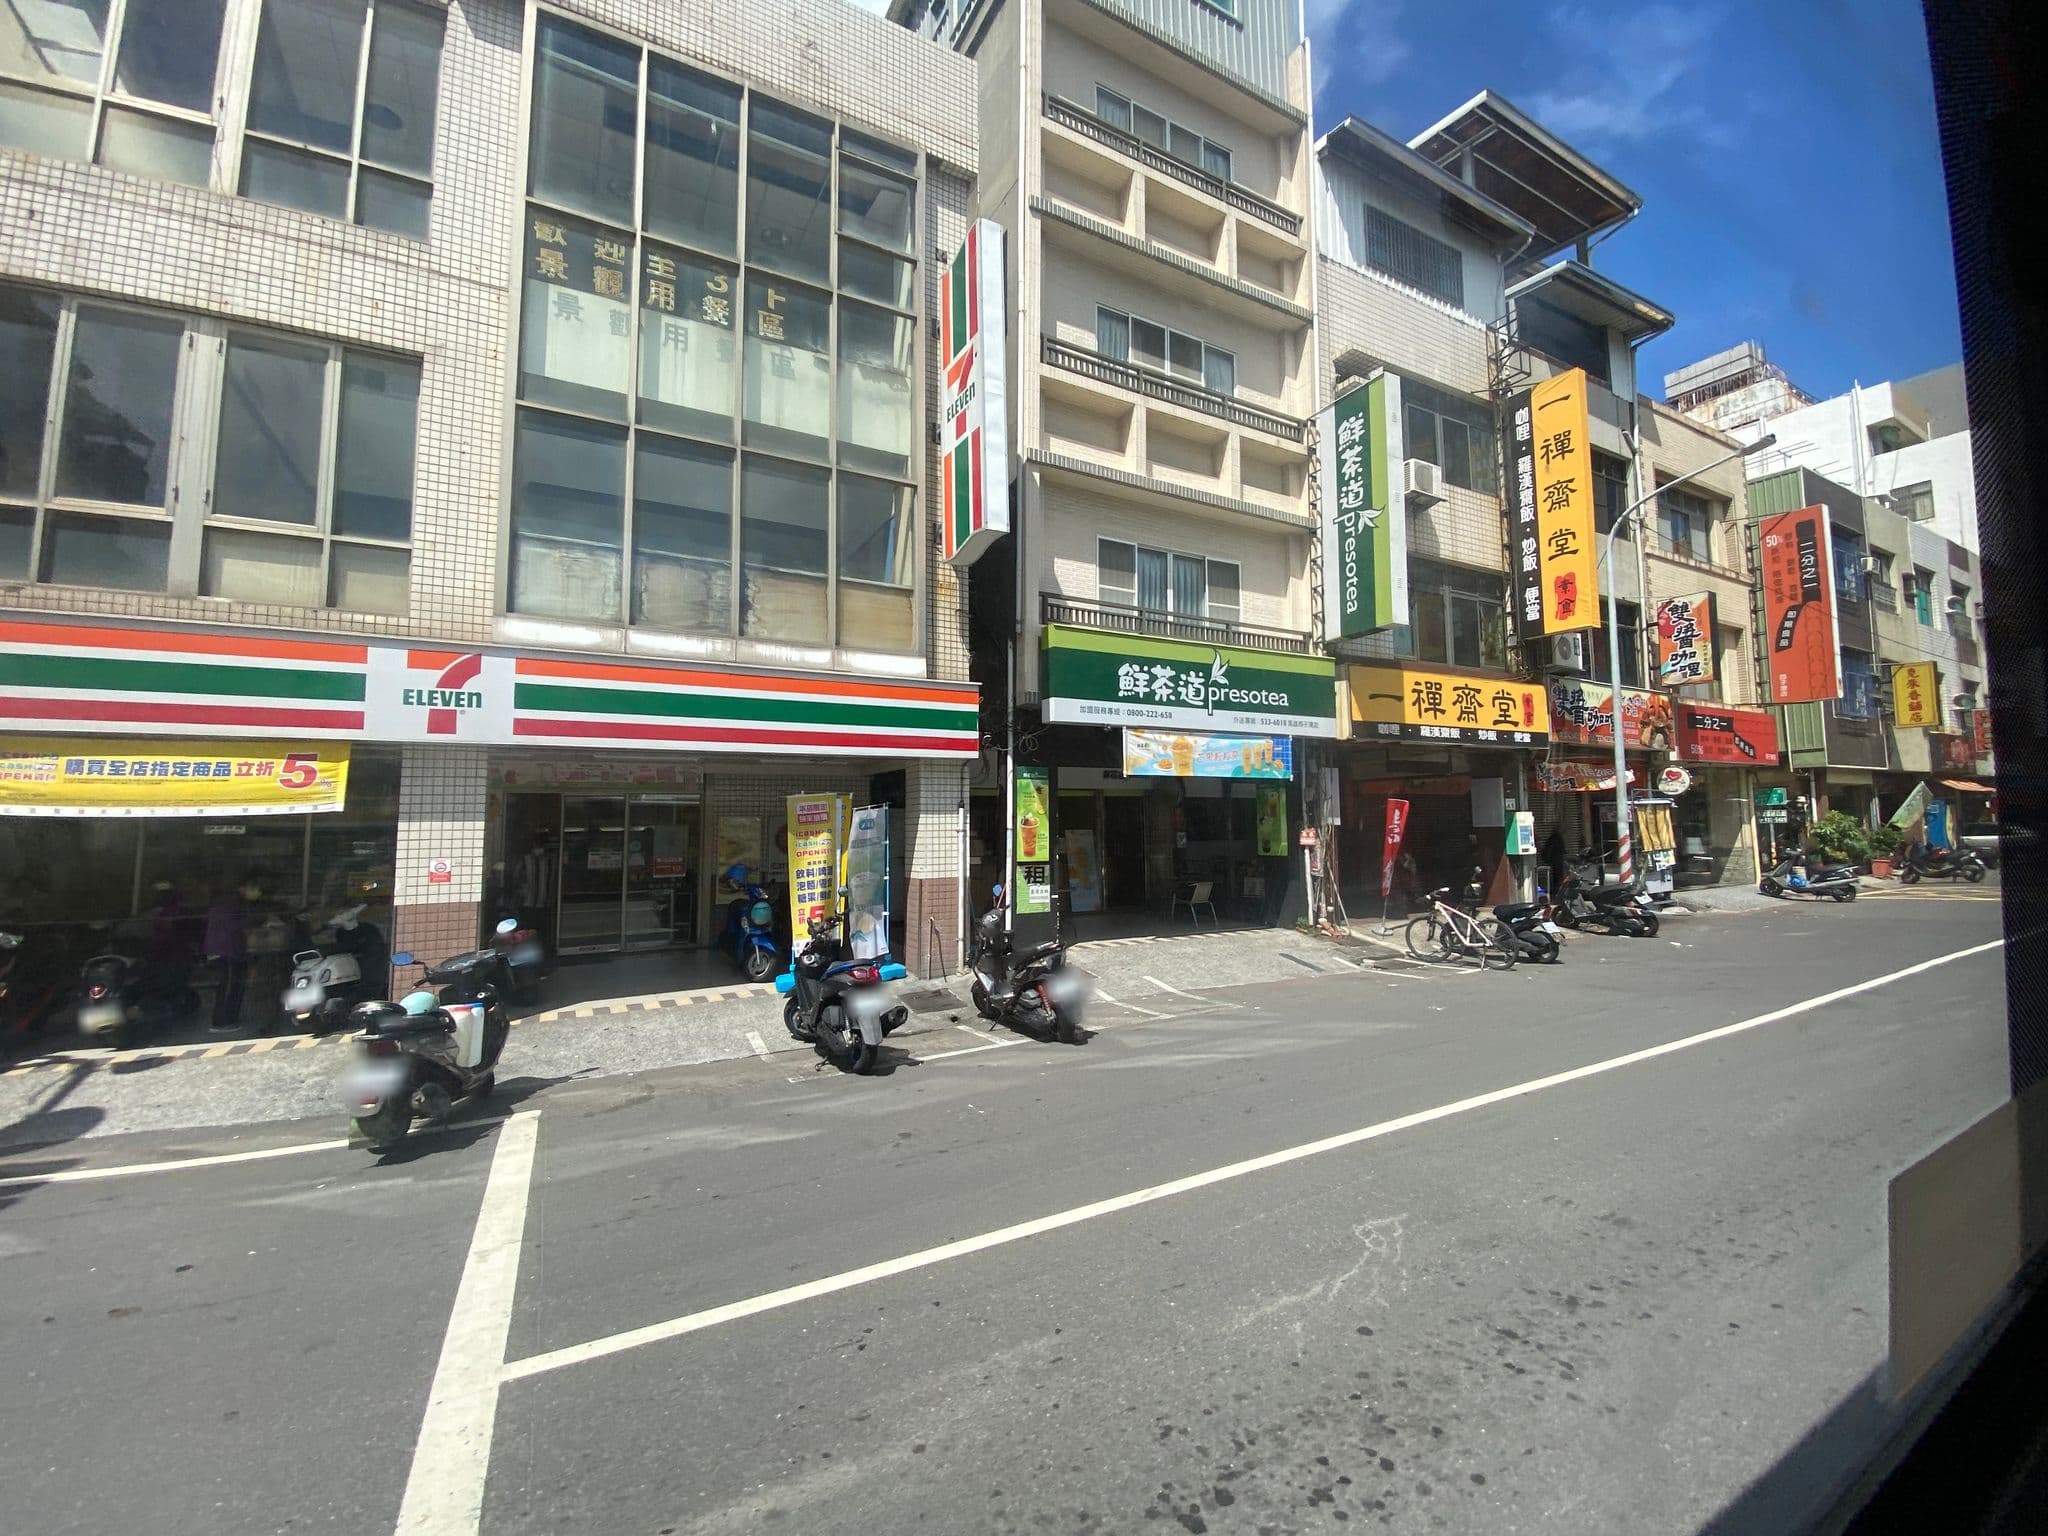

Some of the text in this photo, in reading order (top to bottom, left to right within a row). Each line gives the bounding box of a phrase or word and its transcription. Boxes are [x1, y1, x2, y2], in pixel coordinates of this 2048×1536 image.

[1515, 406, 1530, 441] 咖哩
[1338, 412, 1366, 510] 鮮茶道
[1538, 394, 1579, 561] 一禪齋堂
[1333, 511, 1358, 614] presotea
[1521, 537, 1538, 572] 炒飯
[1800, 541, 1818, 588] 二分之一
[1524, 586, 1540, 621] 便當
[1667, 601, 1702, 677] 雙醬咖哩
[1118, 662, 1205, 706] 鮮茶道
[1207, 686, 1288, 716] presotea
[1369, 681, 1520, 728] 一禪齋堂
[1695, 715, 1728, 730] 二分之一
[64, 758, 231, 777] 購買全店指定商品
[235, 761, 275, 777] 立折
[1024, 866, 1045, 885] 租
